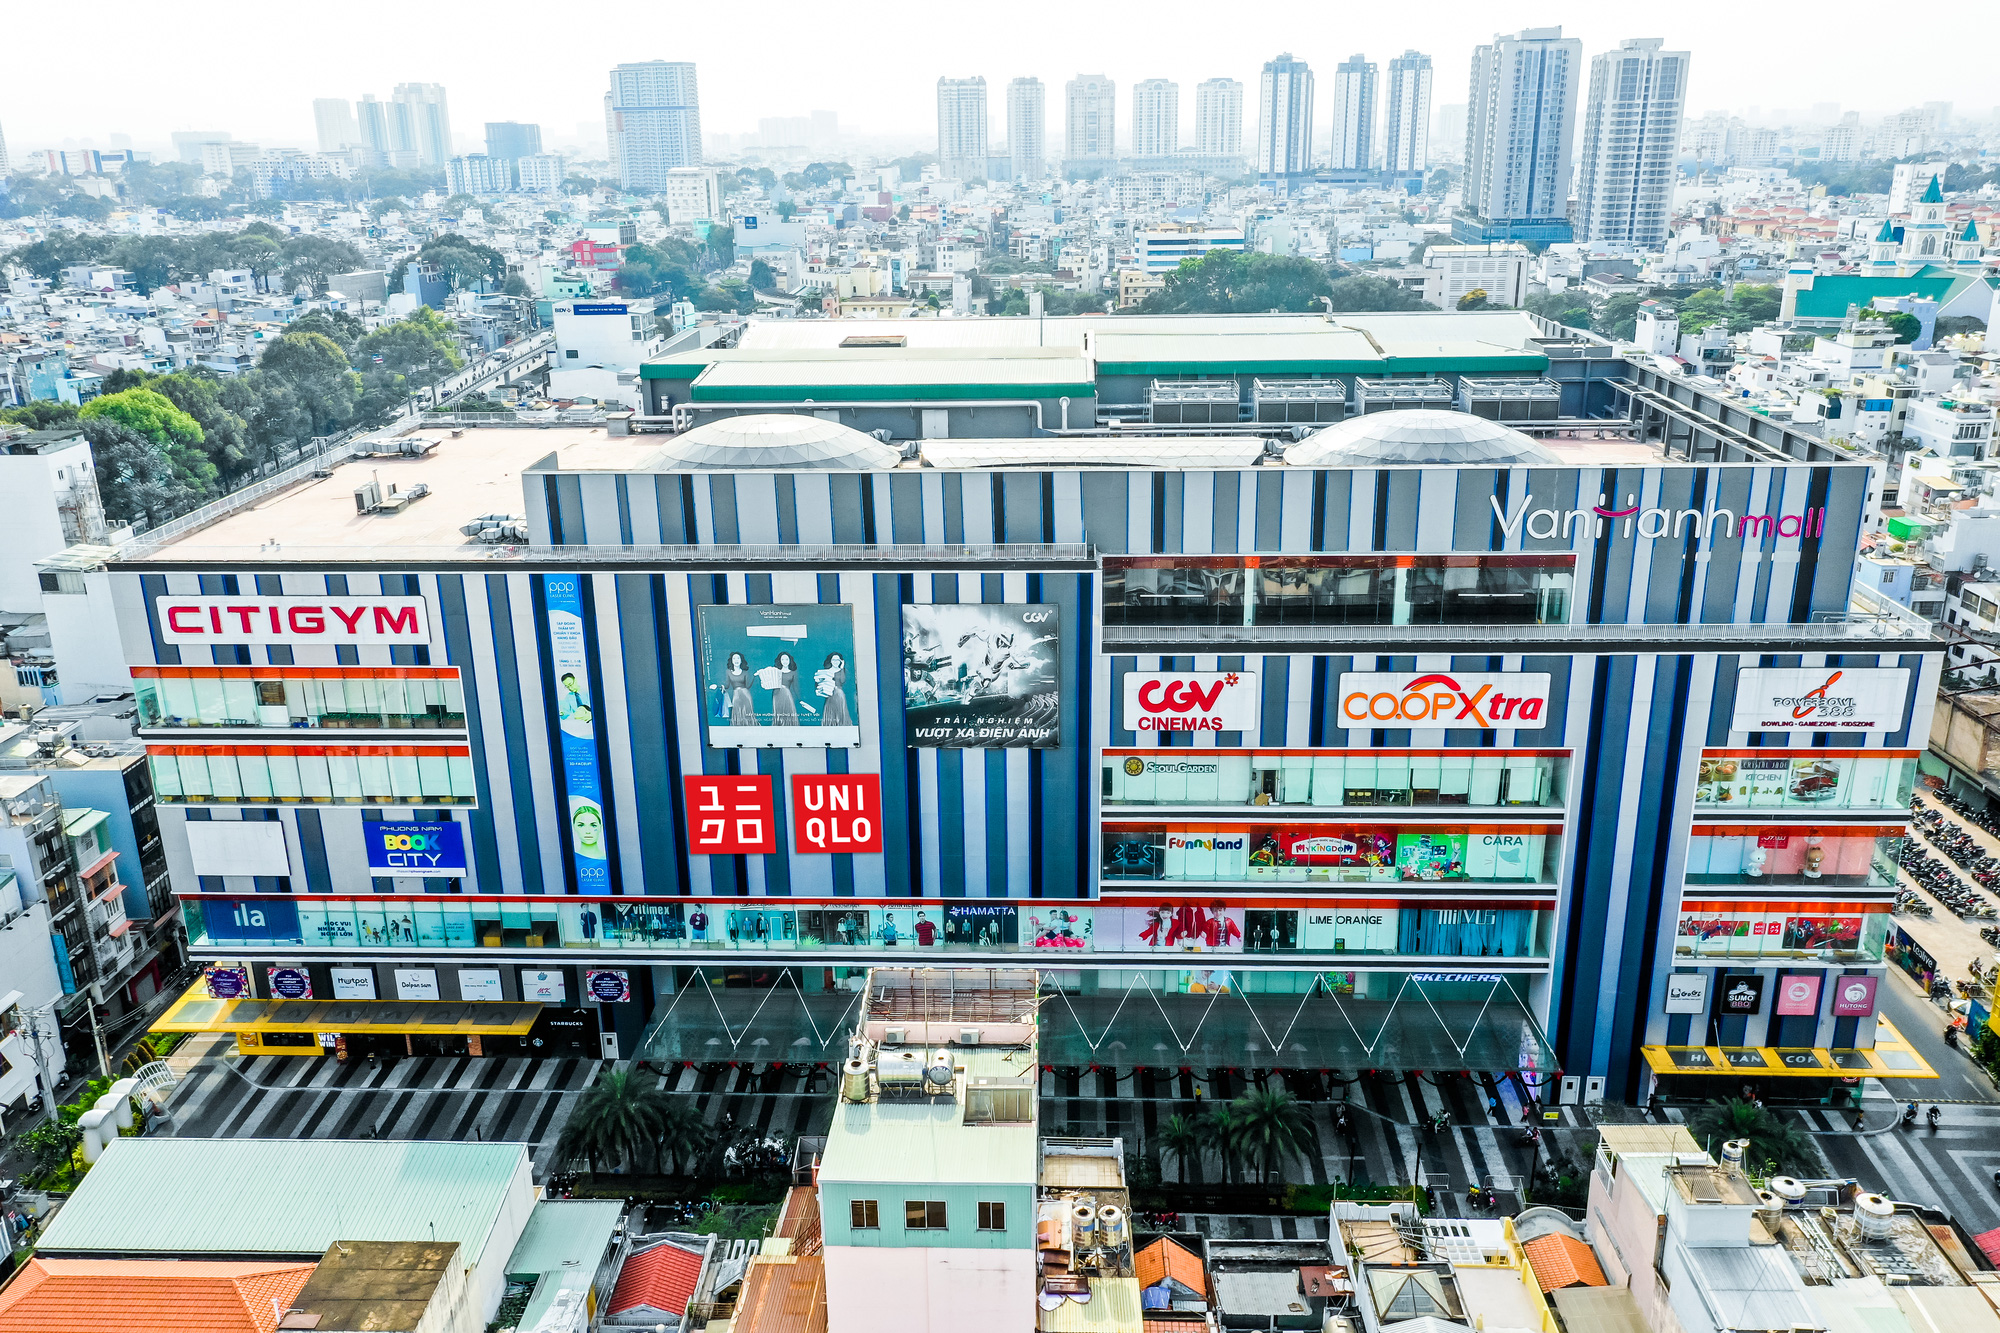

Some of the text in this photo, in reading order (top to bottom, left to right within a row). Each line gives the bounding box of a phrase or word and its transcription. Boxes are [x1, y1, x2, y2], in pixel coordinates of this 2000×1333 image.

[1490, 494, 1824, 539] VanHanh mall
[549, 582, 574, 594] ppp
[168, 605, 420, 635] CITIGYM
[1022, 612, 1048, 622] CGV
[1138, 680, 1224, 713] CGV
[1773, 698, 1856, 707] POWERBOWL
[1817, 706, 1856, 717] 388
[936, 716, 1034, 725] TRẢI NGHIỆM
[1138, 717, 1223, 731] CINEMAS
[915, 725, 1050, 740] VƯỢT XA ĐIỆN ẢNH
[804, 785, 865, 811] UNI
[806, 818, 872, 848] QLO
[384, 834, 441, 850] BOOK
[1168, 838, 1242, 851] Funnyland
[1482, 836, 1523, 846] CARA
[387, 853, 442, 866] CITY
[580, 868, 604, 878] ppp
[232, 902, 266, 926] ila
[633, 904, 670, 915] vitimex
[962, 906, 1016, 916] HAMATTA
[1309, 916, 1382, 924] LIME ORANGE
[1912, 942, 1933, 968] tealive
[1412, 974, 1502, 982] SKECHERS
